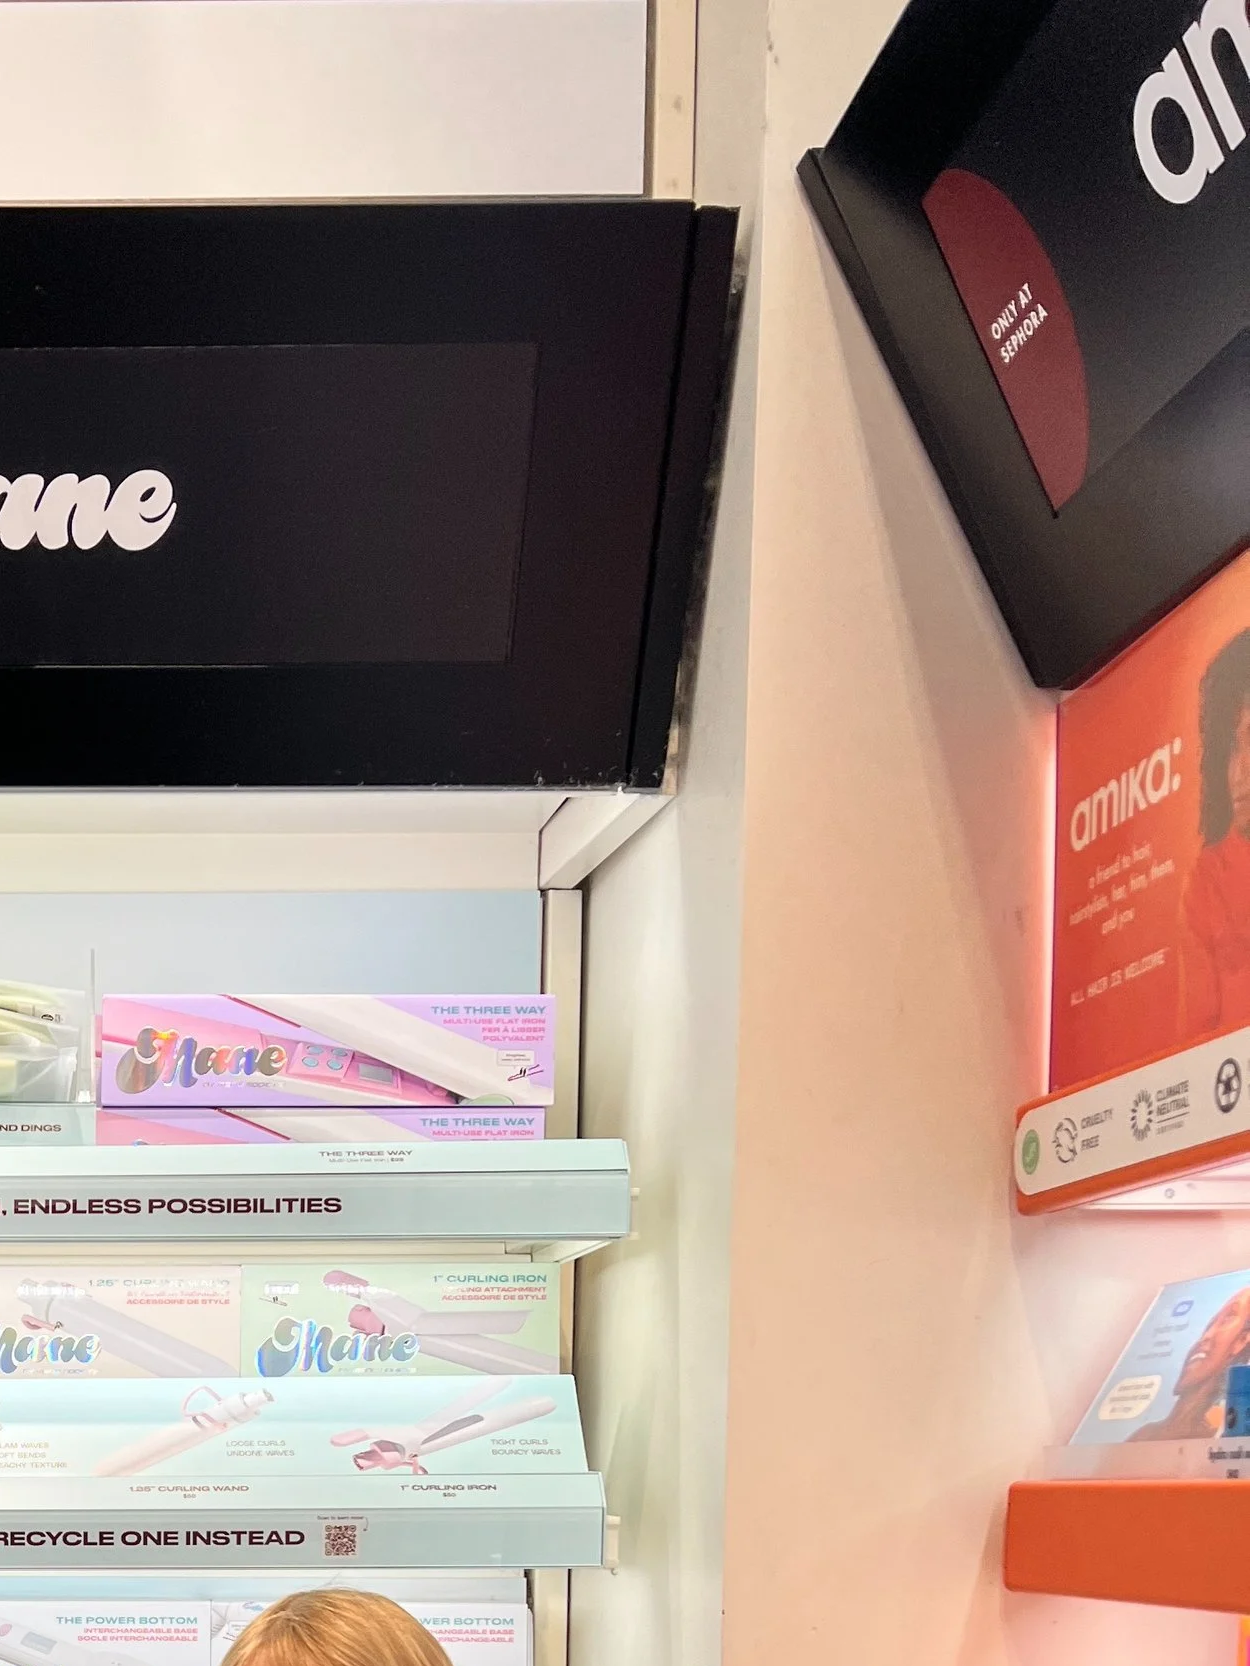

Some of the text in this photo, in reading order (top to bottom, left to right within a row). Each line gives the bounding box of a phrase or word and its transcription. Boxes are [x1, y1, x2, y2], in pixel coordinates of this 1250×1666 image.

[991, 282, 1033, 340] ONLY AT
[1000, 303, 1049, 363] SEPHORA
[1070, 737, 1182, 852] amika:
[430, 1005, 547, 1015] THE THREE WAY
[20, 1124, 62, 1132] DINGS
[13, 1198, 142, 1215] ENDLESS
[148, 1197, 342, 1214] POSSIBILITIES
[120, 1530, 179, 1546] ONE
[185, 1530, 305, 1546] INSTEAD
[55, 1616, 198, 1625] THE POWER BOTTOM
